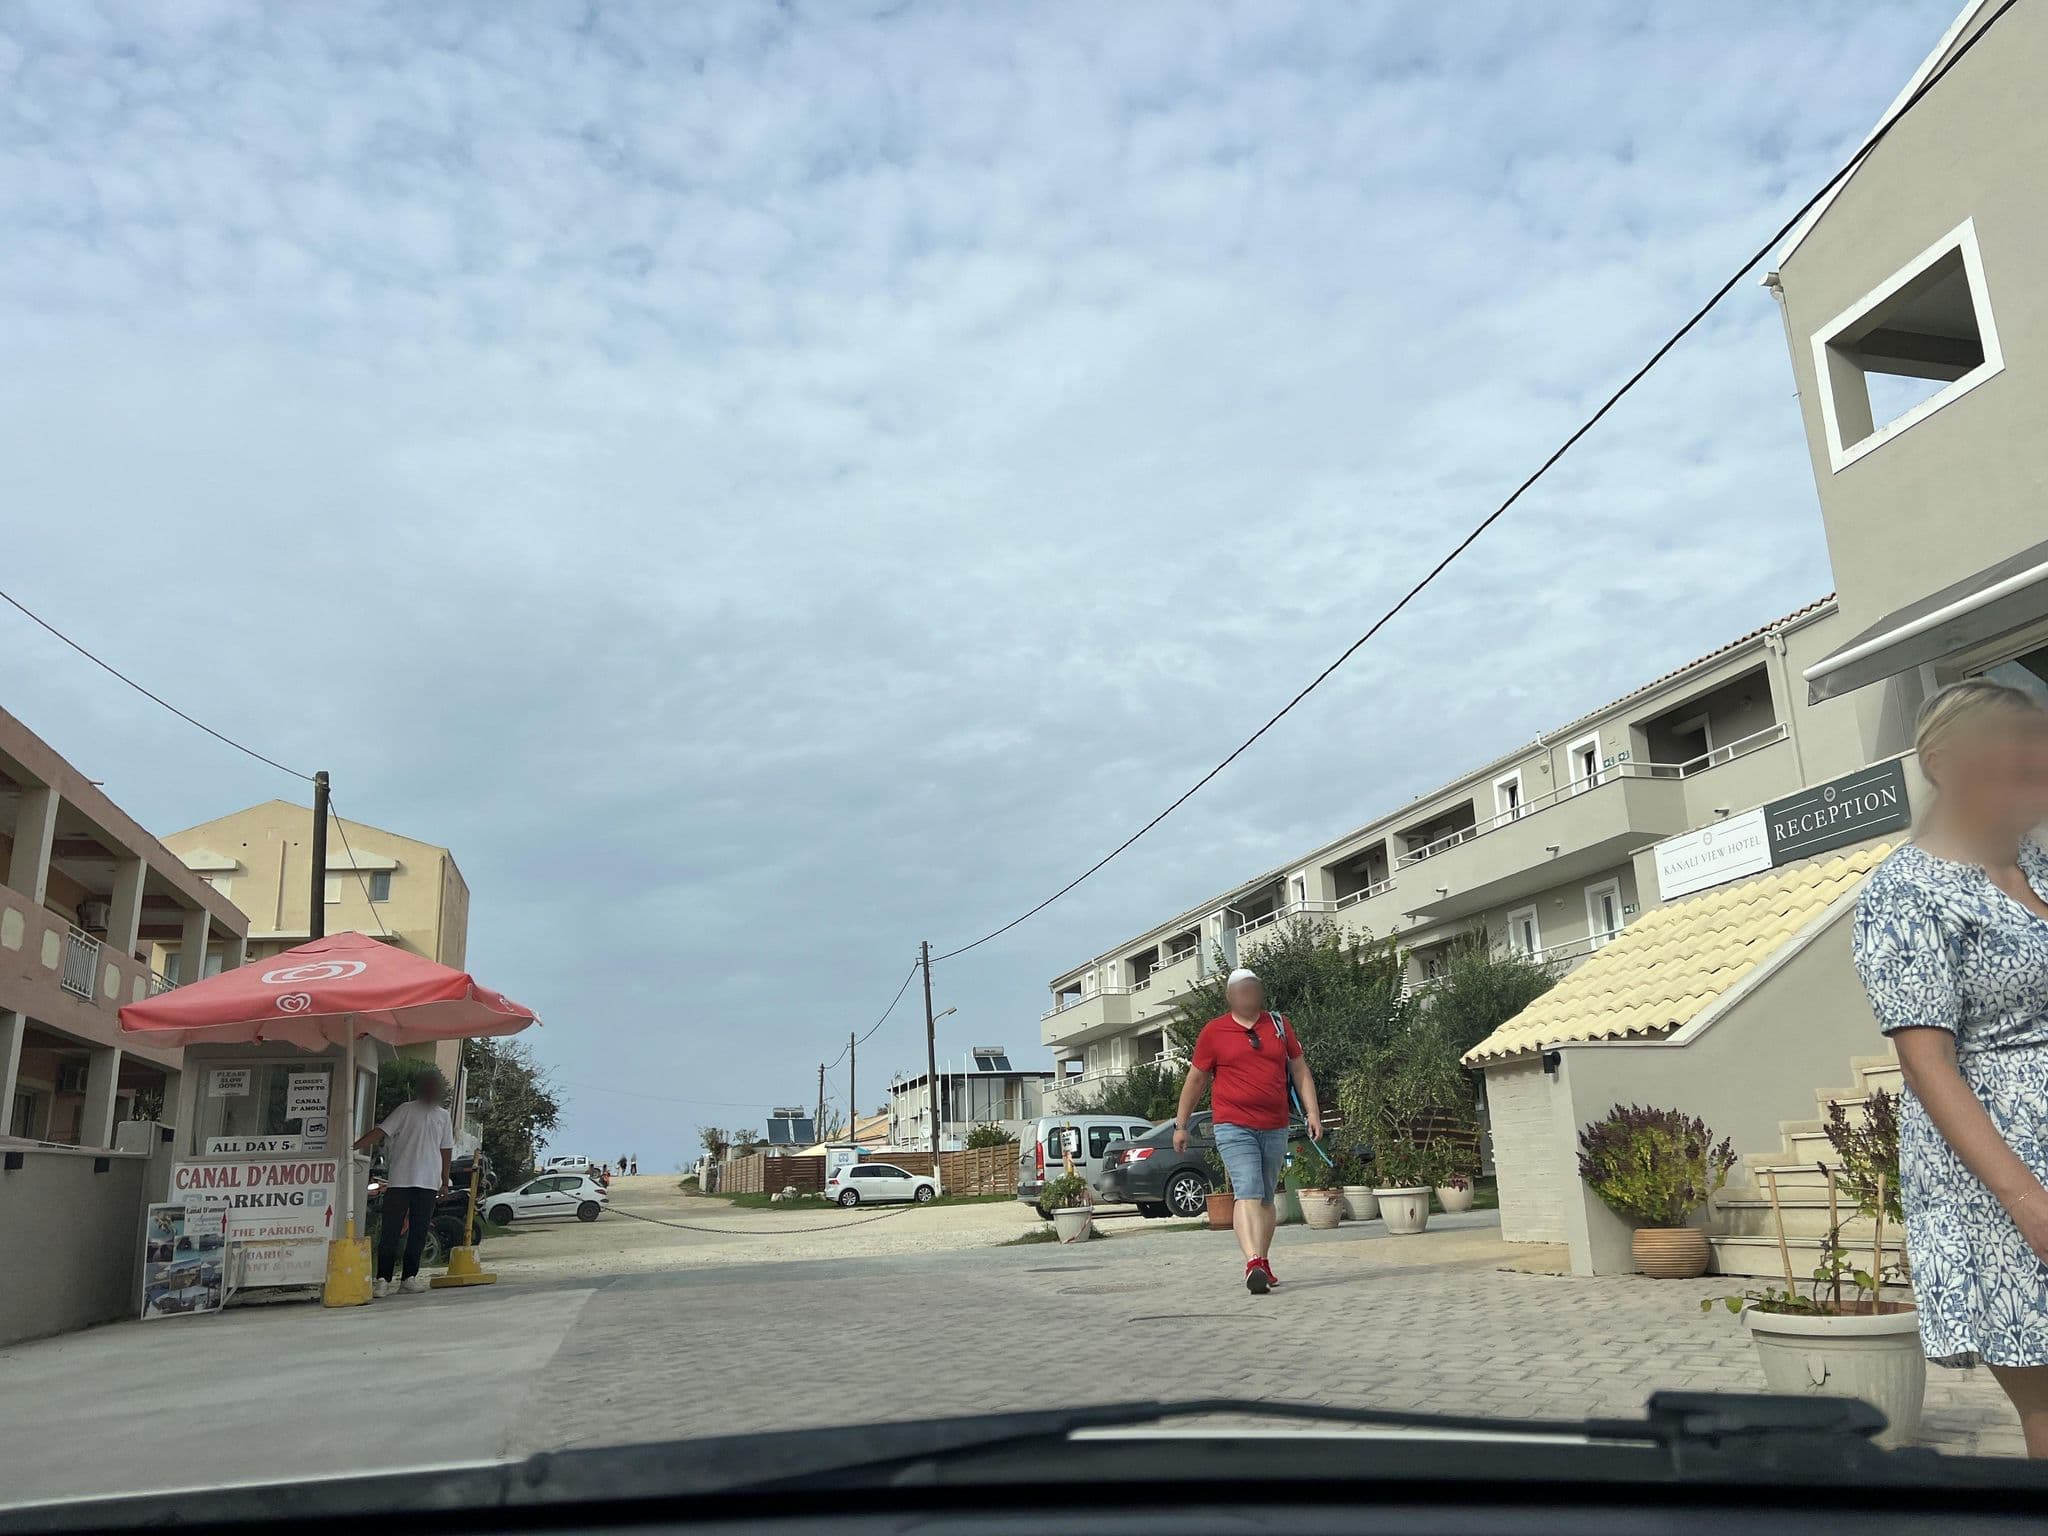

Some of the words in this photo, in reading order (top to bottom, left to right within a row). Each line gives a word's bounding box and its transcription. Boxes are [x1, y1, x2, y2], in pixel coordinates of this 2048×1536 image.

[1773, 785, 1898, 841] RECEPTION
[1663, 857, 1699, 876] KANALI
[1701, 848, 1725, 863] VIEW
[1728, 835, 1761, 855] HOTEL
[213, 1142, 241, 1153] ALL
[245, 1141, 278, 1152] DAY
[175, 1166, 241, 1190] CANAL
[247, 1162, 336, 1188] D'AMOUR
[231, 1228, 256, 1238] THE
[259, 1225, 315, 1236] PARKING
